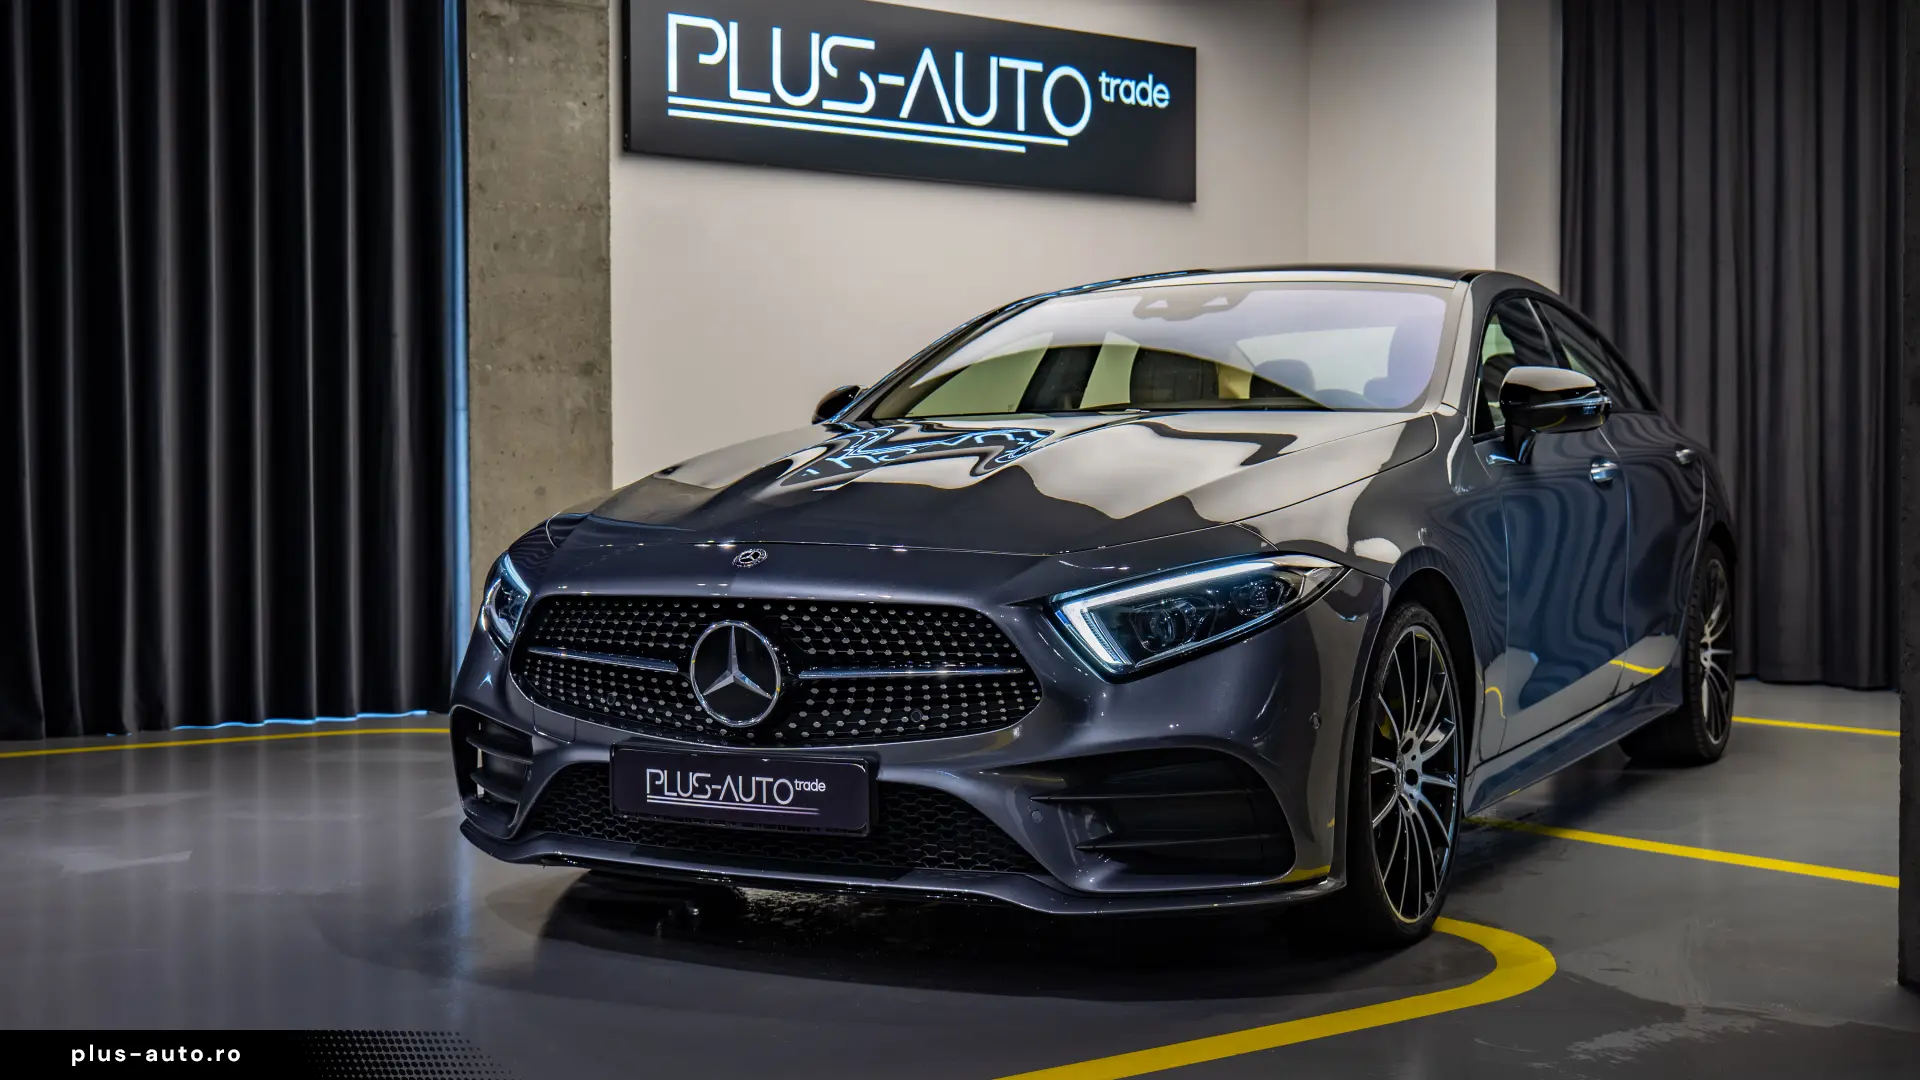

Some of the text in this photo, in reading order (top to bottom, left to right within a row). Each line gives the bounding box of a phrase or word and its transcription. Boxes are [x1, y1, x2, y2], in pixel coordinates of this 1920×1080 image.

[667, 13, 1170, 136] PLUS-AUTO trade
[646, 768, 826, 804] PLUS-AUTO trade
